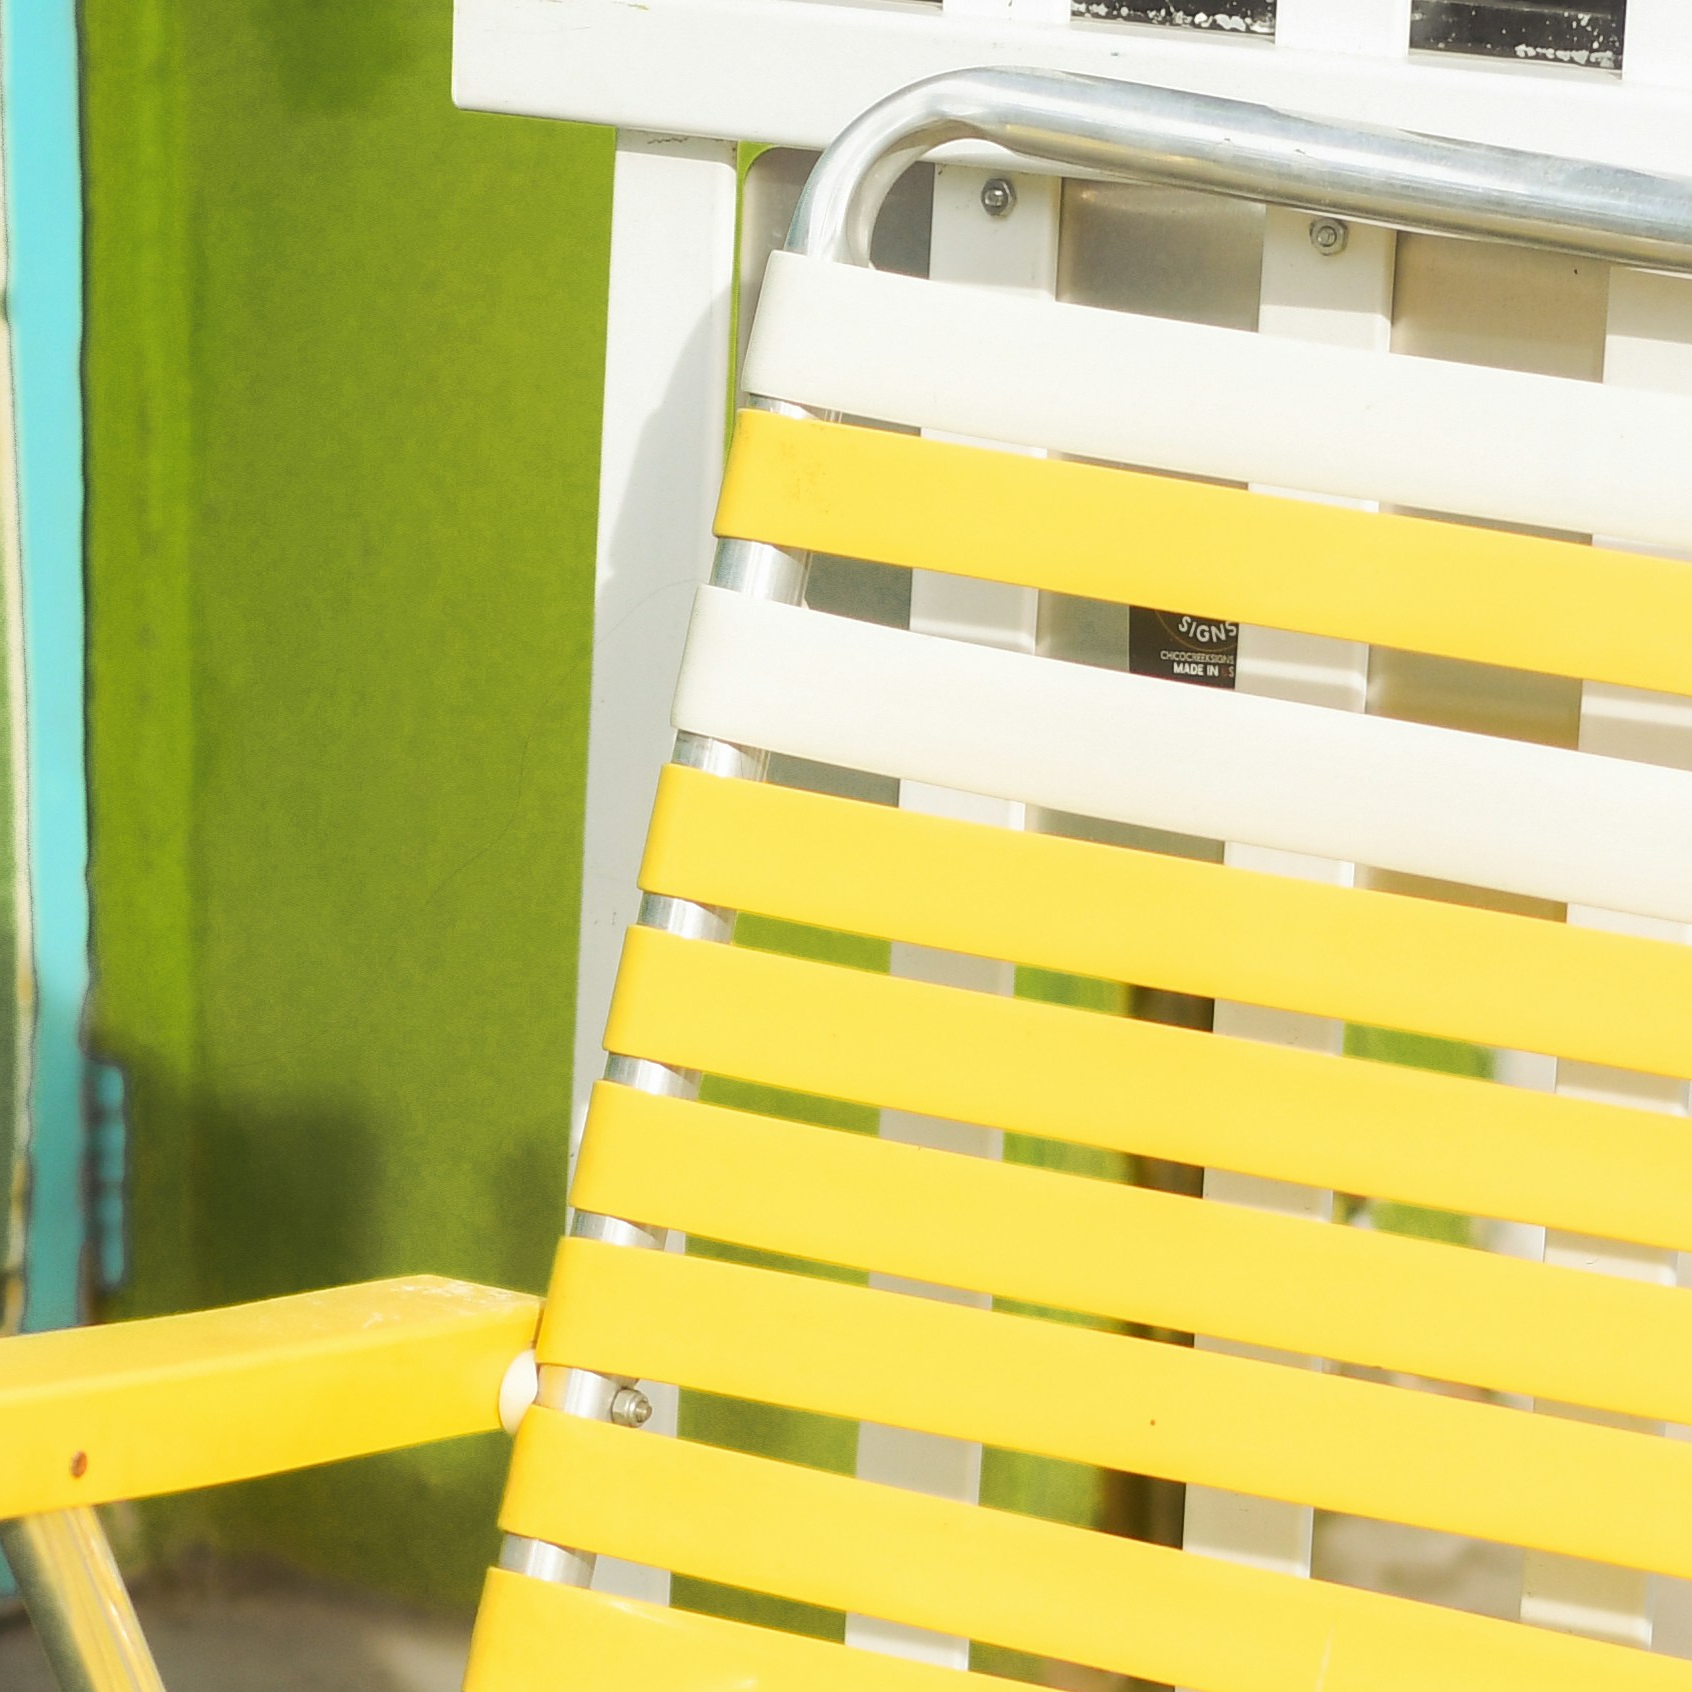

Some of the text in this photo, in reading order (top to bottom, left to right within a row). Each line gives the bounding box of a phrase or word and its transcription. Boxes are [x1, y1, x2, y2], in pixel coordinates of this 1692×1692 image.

[1178, 616, 1237, 642] SIGNS
[1174, 663, 1204, 676] MADE
[1207, 665, 1219, 677] IN
